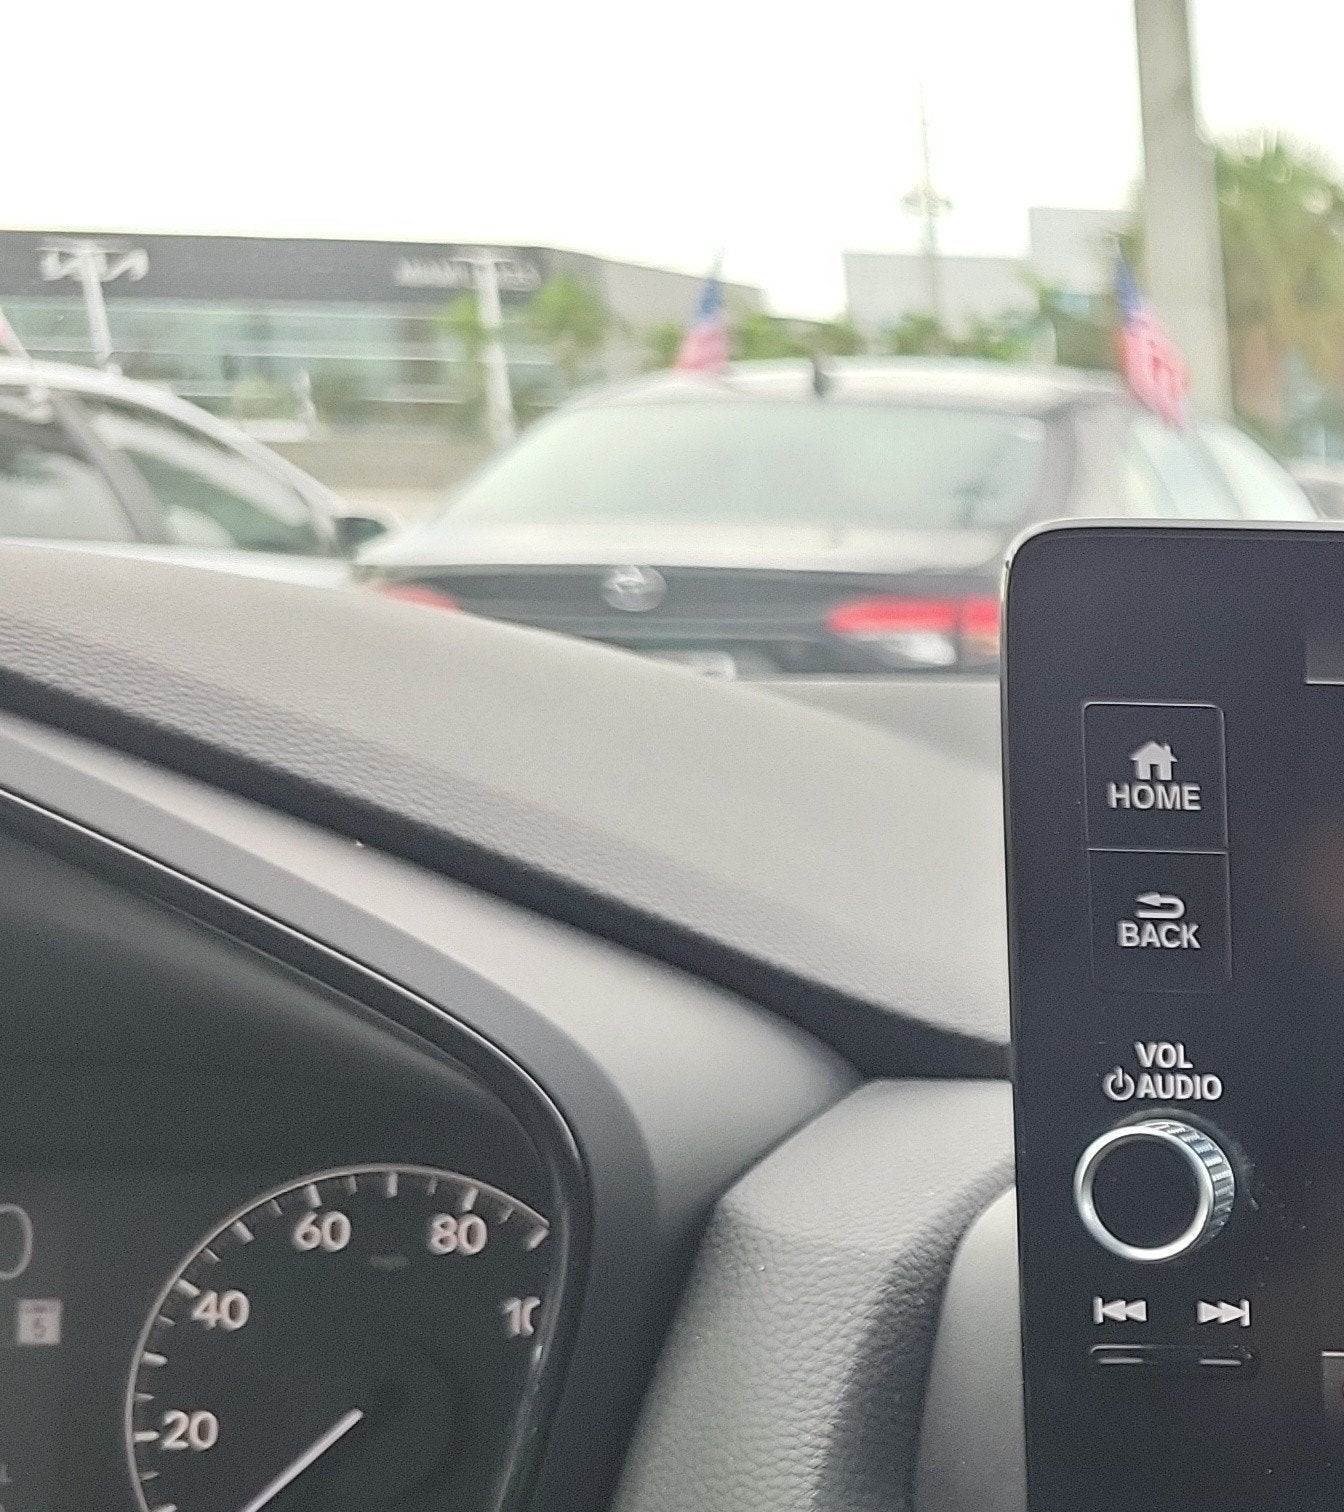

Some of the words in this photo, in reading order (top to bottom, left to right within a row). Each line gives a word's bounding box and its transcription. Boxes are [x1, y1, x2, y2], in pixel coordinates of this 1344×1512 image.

[1107, 782, 1202, 811] HOME
[1117, 920, 1202, 949] BACK
[1134, 1041, 1194, 1069] VOL
[1135, 1073, 1223, 1101] AUDIO
[294, 1211, 352, 1252] 60
[430, 1213, 488, 1255] 80
[193, 1290, 250, 1330] 40
[162, 1410, 219, 1451] 20
